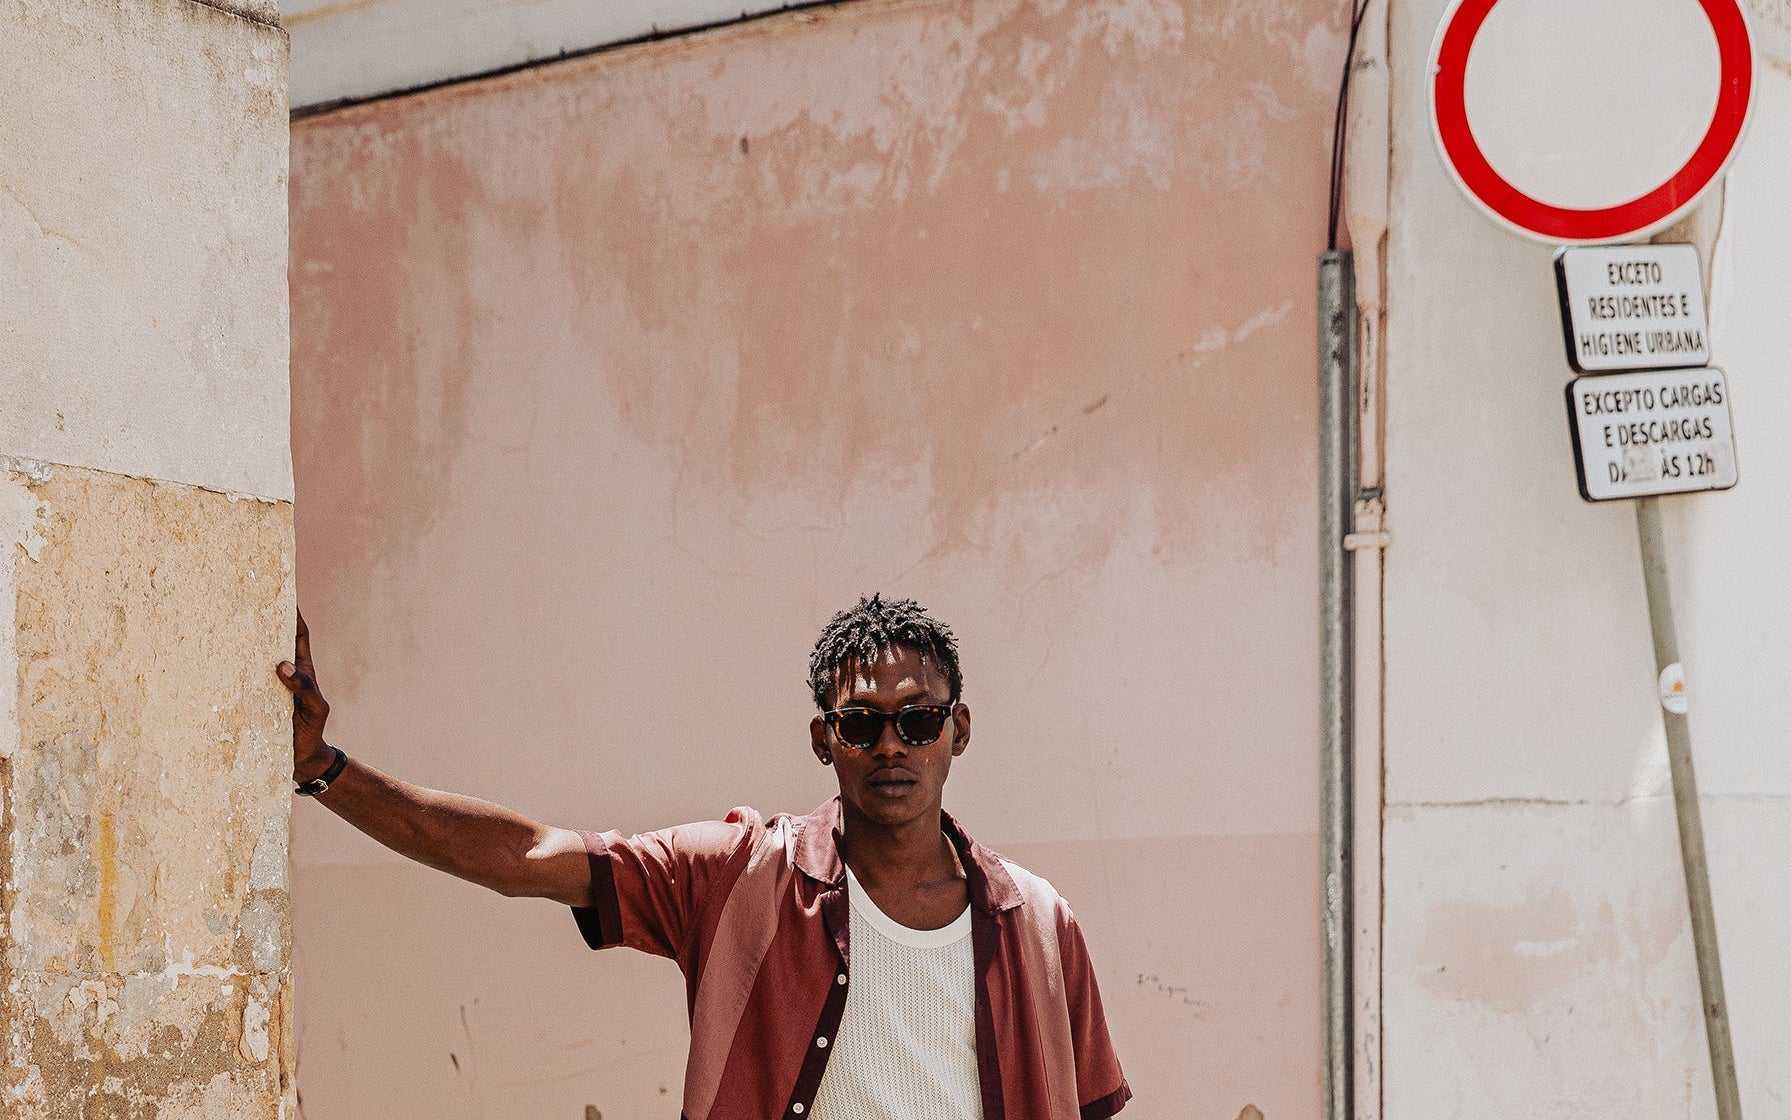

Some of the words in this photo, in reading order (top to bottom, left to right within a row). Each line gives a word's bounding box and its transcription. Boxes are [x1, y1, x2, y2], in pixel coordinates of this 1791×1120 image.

[1607, 262, 1662, 285] EXCETO
[1588, 295, 1677, 320] RESIDENTES
[1681, 293, 1689, 317] E
[1580, 333, 1643, 356] HIGIENE
[1645, 330, 1703, 353] URBANA
[1584, 389, 1655, 415] EXCEPTO
[1659, 383, 1723, 409] CARGAS
[1604, 426, 1613, 447] E
[1618, 417, 1713, 446] DESCARGAS
[1687, 453, 1715, 476] 12h
